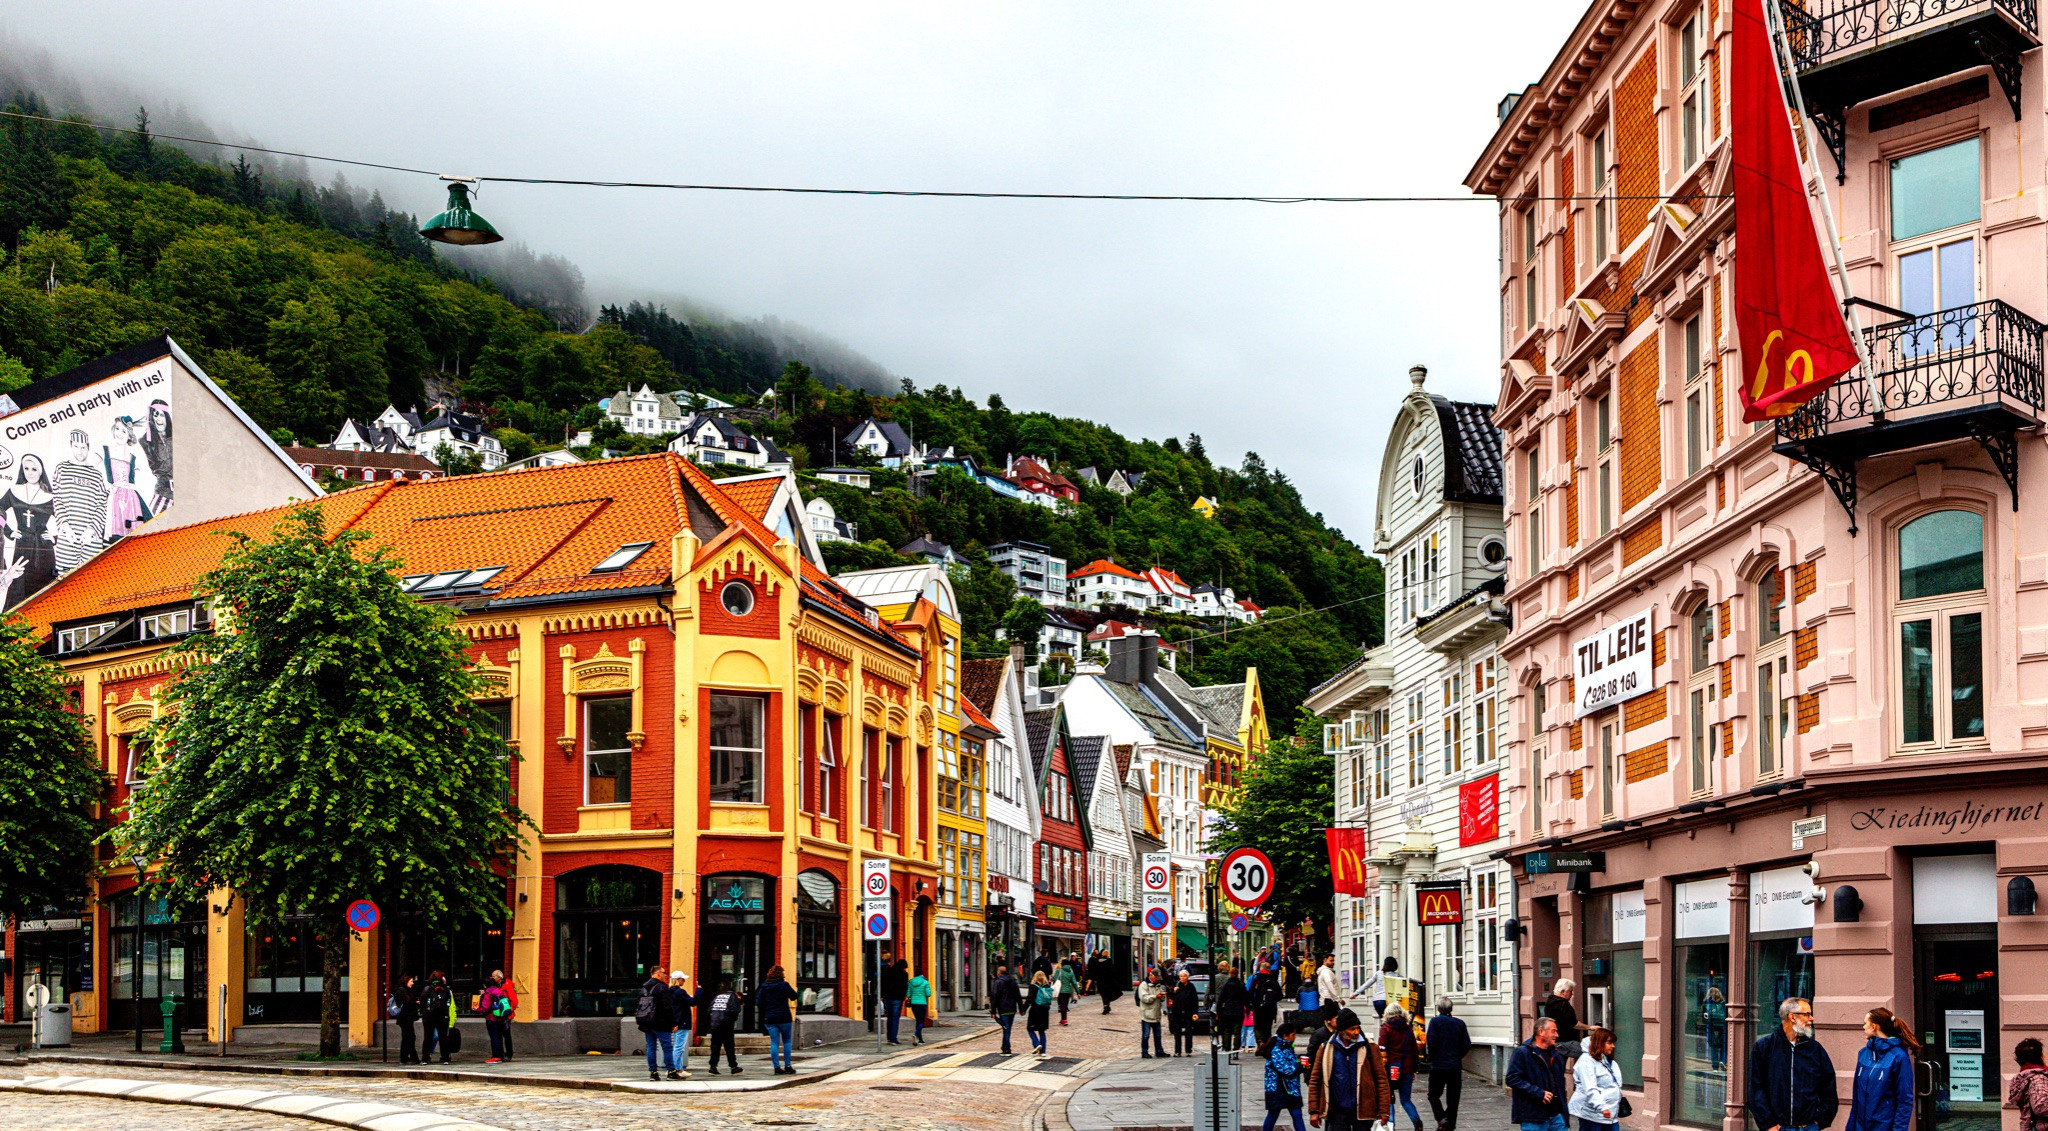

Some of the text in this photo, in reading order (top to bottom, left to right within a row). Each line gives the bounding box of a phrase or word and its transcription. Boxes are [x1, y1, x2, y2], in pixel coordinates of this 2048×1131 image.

[5, 369, 165, 441] Come and party with us!
[1578, 617, 1646, 678] TIL LEIE
[1591, 671, 1637, 704] 926 08 160
[1850, 800, 2045, 835] Kiedinghjørnet
[1146, 854, 1166, 863] Sone
[1529, 857, 1592, 869] DNB Minibank
[868, 861, 886, 869] Sone
[1149, 872, 1164, 884] 30
[1231, 862, 1265, 892] 30
[870, 878, 884, 890] 30
[1146, 895, 1168, 904] Sone
[1772, 892, 1782, 902] DNB
[1783, 890, 1802, 901] Eiendom
[710, 899, 763, 909] AGAVE
[868, 902, 887, 910] Sone
[1701, 901, 1718, 910] Eiendom
[146, 913, 180, 923] AGAV
